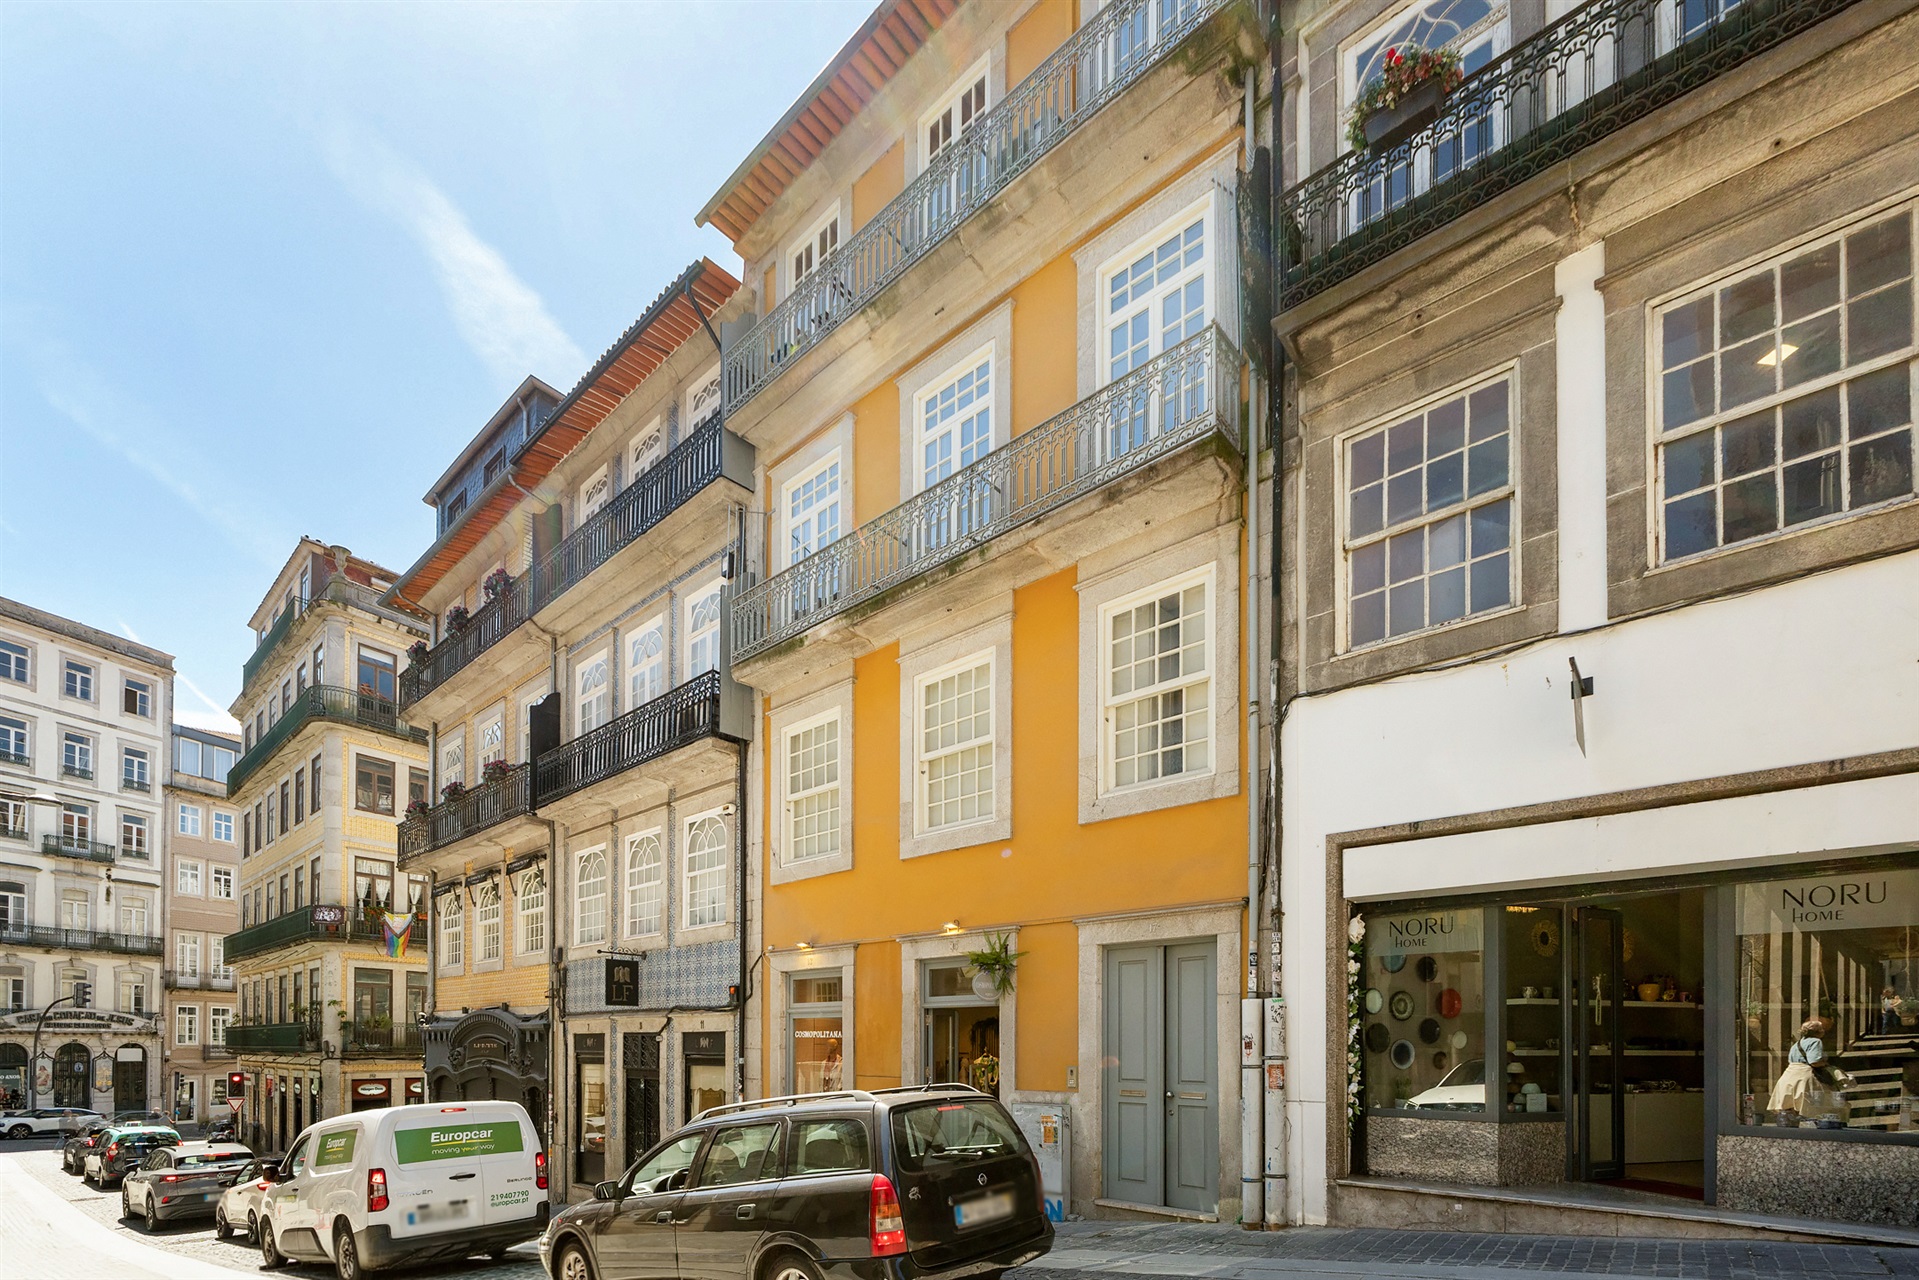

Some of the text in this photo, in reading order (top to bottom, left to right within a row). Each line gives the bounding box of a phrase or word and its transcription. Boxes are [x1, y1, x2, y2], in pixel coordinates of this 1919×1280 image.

[1783, 881, 1886, 909] NORU
[1792, 908, 1844, 922] HOME
[1389, 916, 1454, 937] NORU
[1395, 936, 1428, 948] HOME
[612, 984, 633, 1001] LF
[106, 1013, 135, 1026] JESUS
[794, 1030, 843, 1038] COSMOPOLITANA
[430, 1129, 494, 1143] Europcar
[326, 1138, 347, 1150] Europcar
[431, 1147, 460, 1155] moving
[490, 1190, 529, 1202] 219407790
[490, 1197, 529, 1208] europcar.pt
